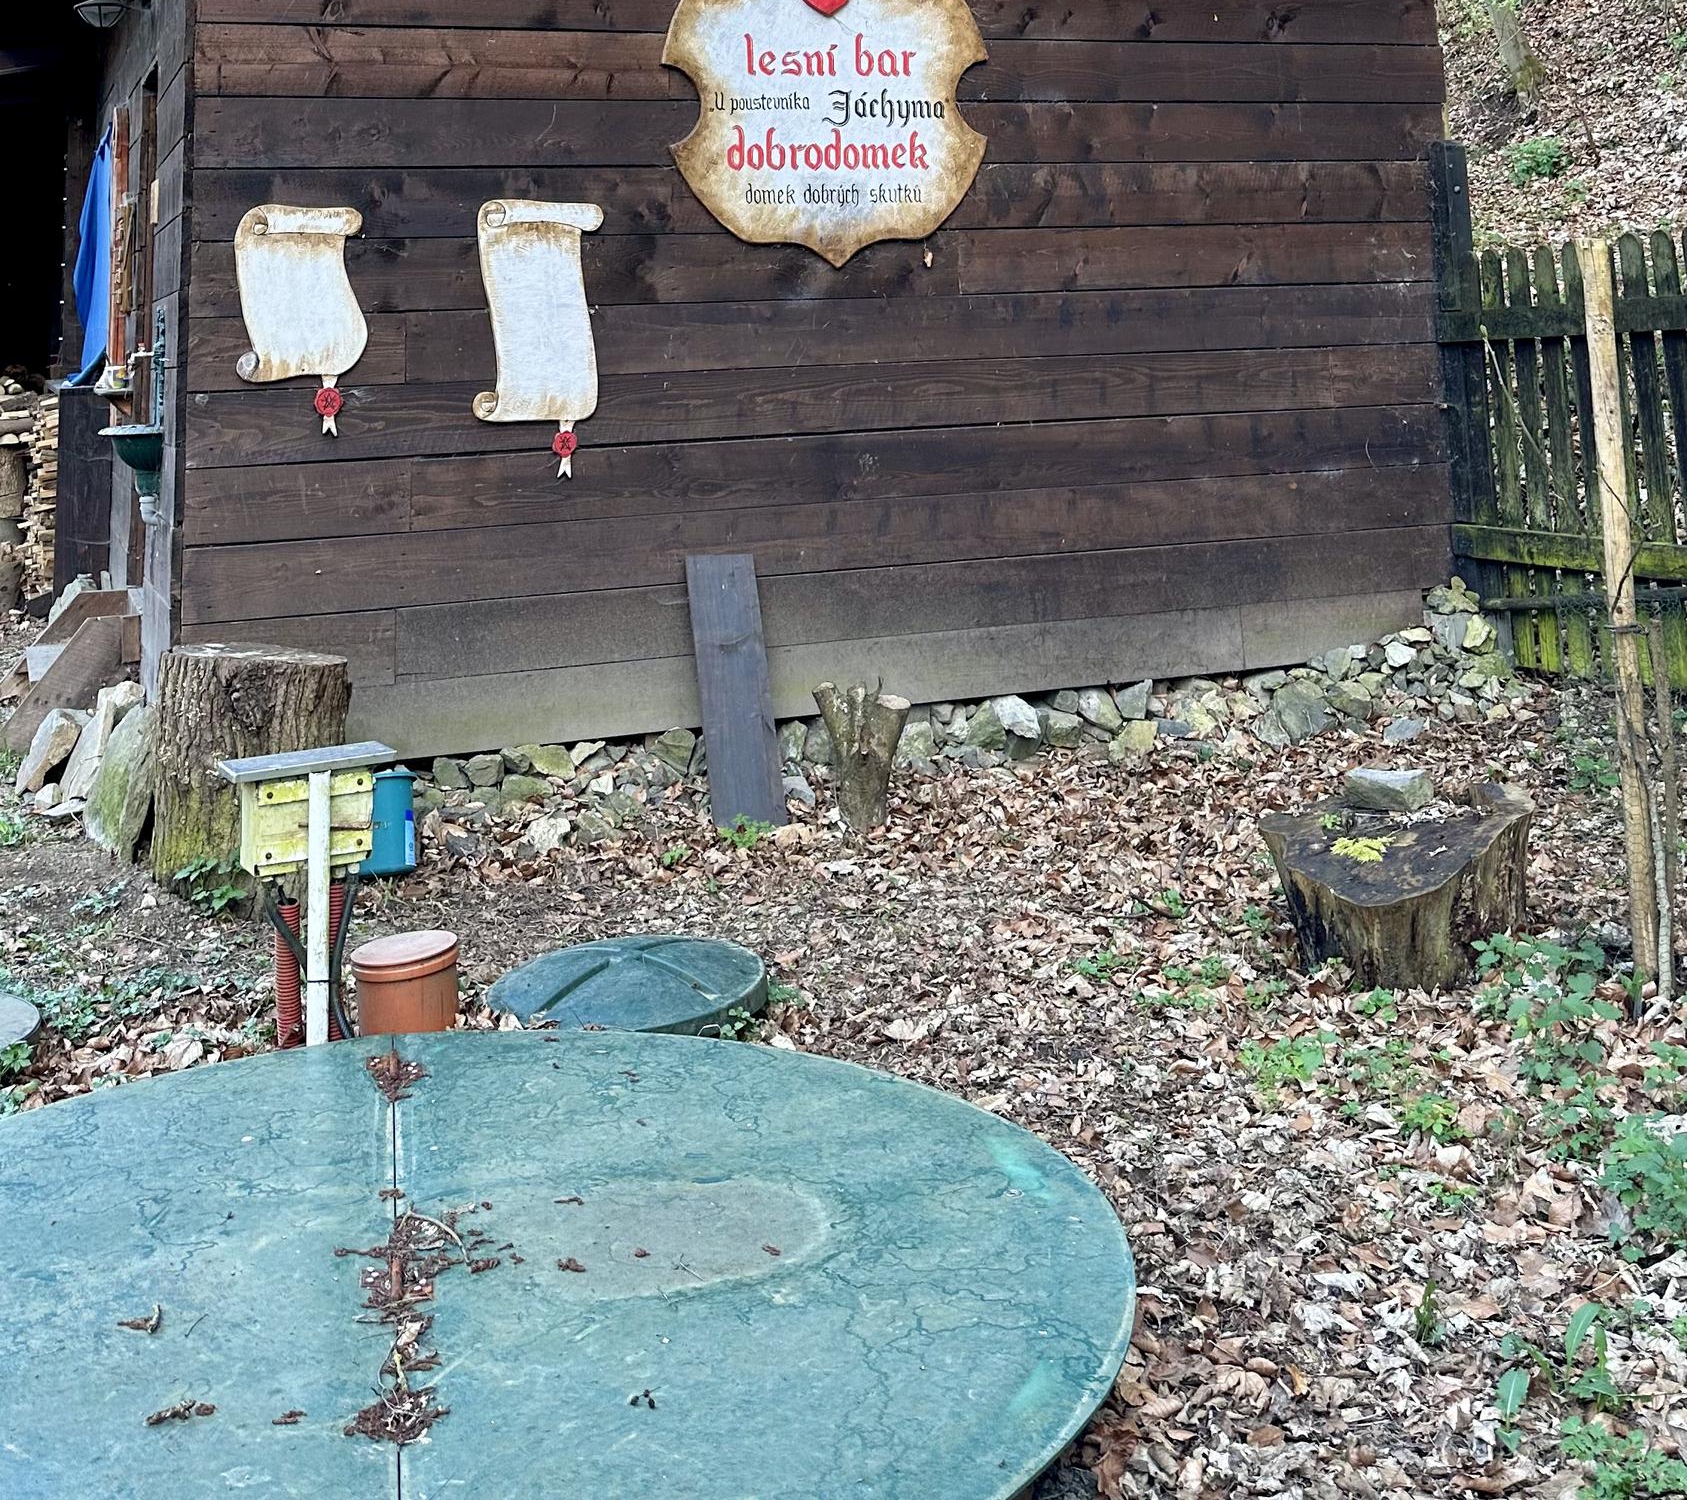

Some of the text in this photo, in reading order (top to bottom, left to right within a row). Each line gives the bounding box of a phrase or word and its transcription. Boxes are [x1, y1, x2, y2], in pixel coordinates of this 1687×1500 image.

[744, 33, 917, 77] lesní bar
[730, 92, 811, 115] poustevníka
[822, 88, 945, 127] Jáchyma
[727, 125, 929, 171] dobrodomek
[745, 183, 922, 208] domek dobrých skutků
